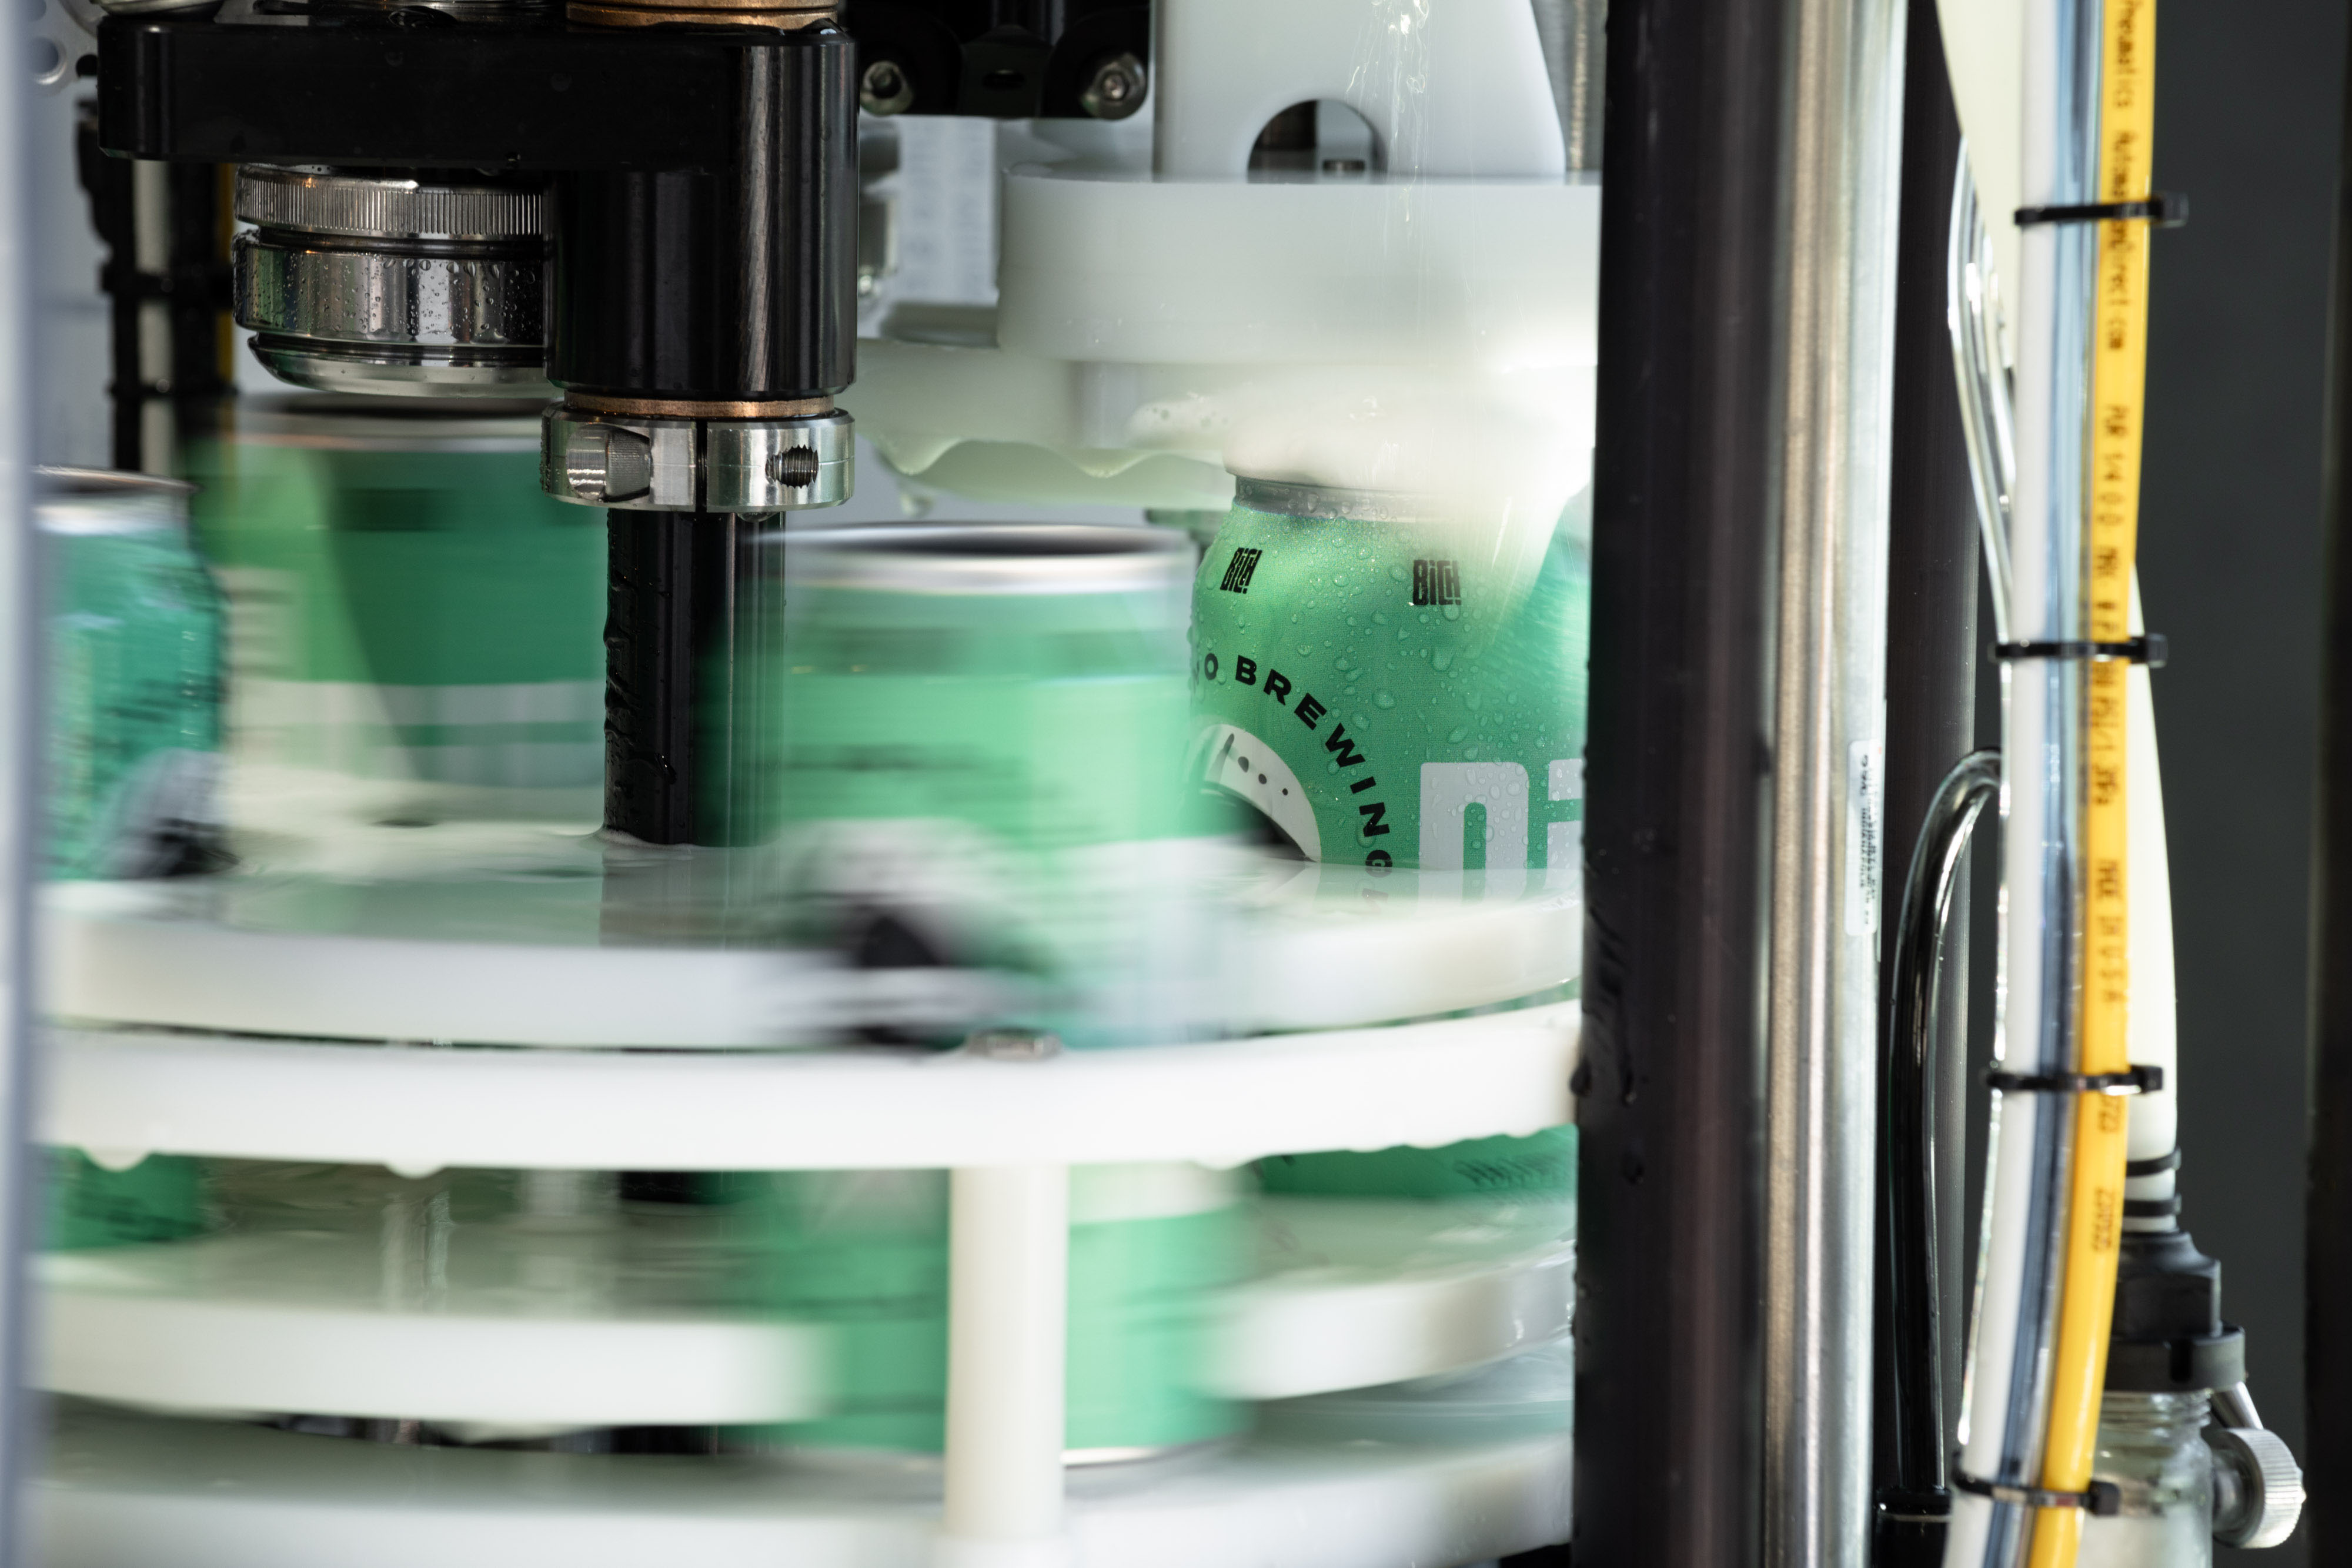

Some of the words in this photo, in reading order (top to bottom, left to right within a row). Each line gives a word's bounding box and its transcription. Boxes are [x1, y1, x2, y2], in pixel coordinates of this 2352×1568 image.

[1235, 655, 1392, 878] BREWING
[2094, 858, 2124, 901] MADE
[2097, 915, 2124, 938] IN
